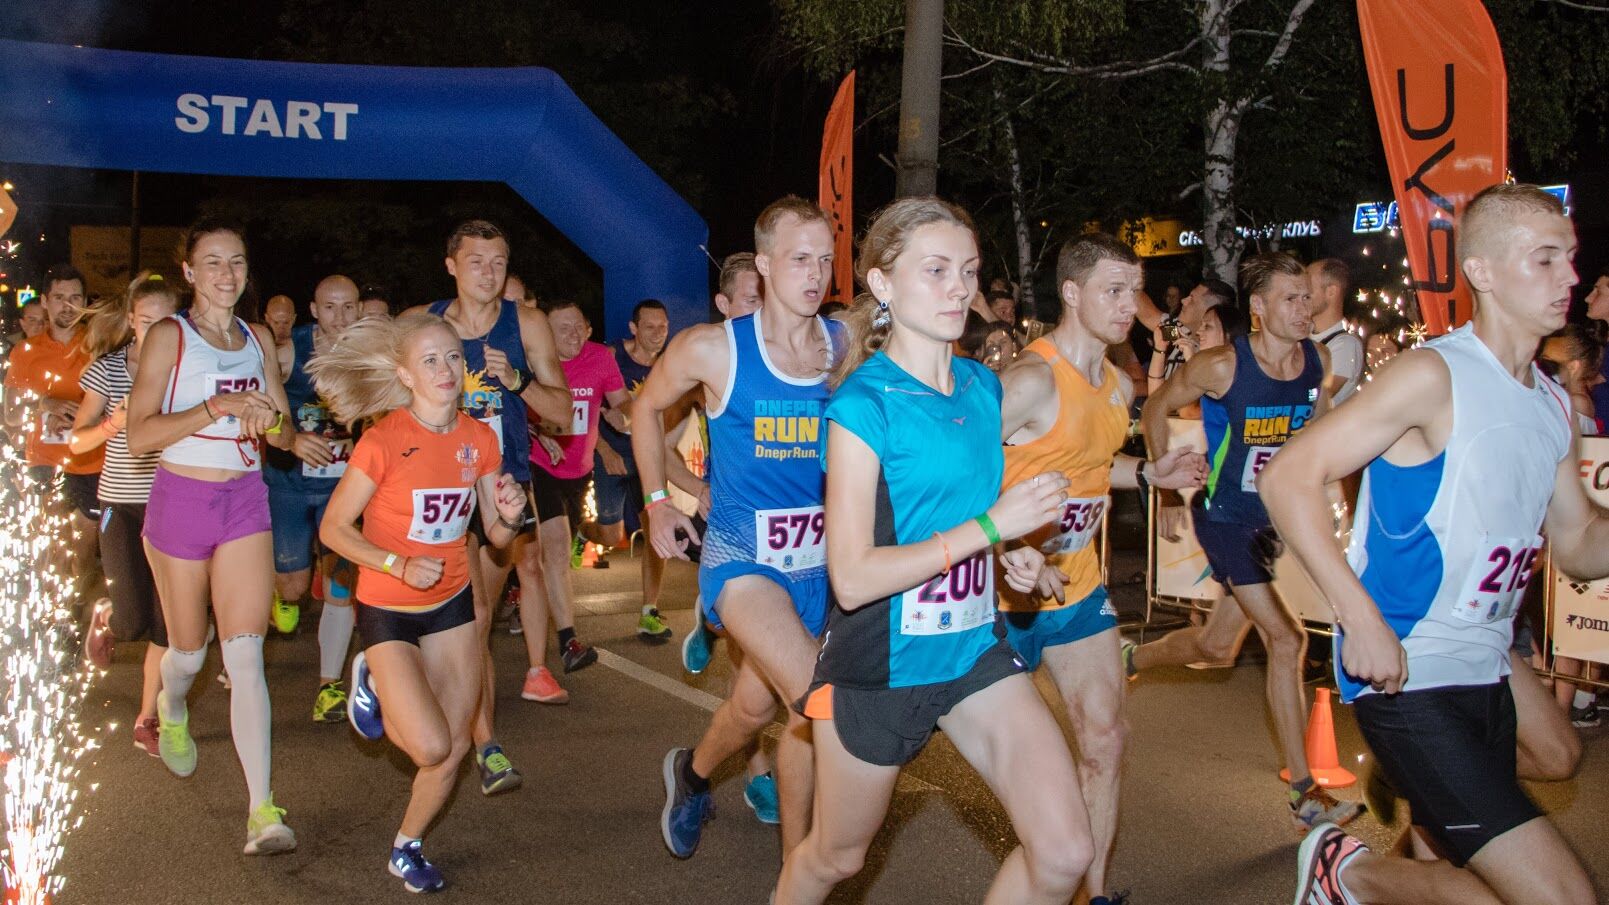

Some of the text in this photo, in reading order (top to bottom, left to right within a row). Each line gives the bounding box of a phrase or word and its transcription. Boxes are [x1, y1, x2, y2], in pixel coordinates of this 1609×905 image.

[175, 93, 359, 140] START
[755, 400, 820, 417] DNEPR
[1246, 406, 1291, 419] DNEPR
[755, 417, 819, 443] RUN
[1244, 416, 1290, 437] RUN
[423, 490, 472, 524] 574
[1060, 501, 1105, 532] 539
[768, 512, 825, 550] 579
[1478, 545, 1541, 594] 215
